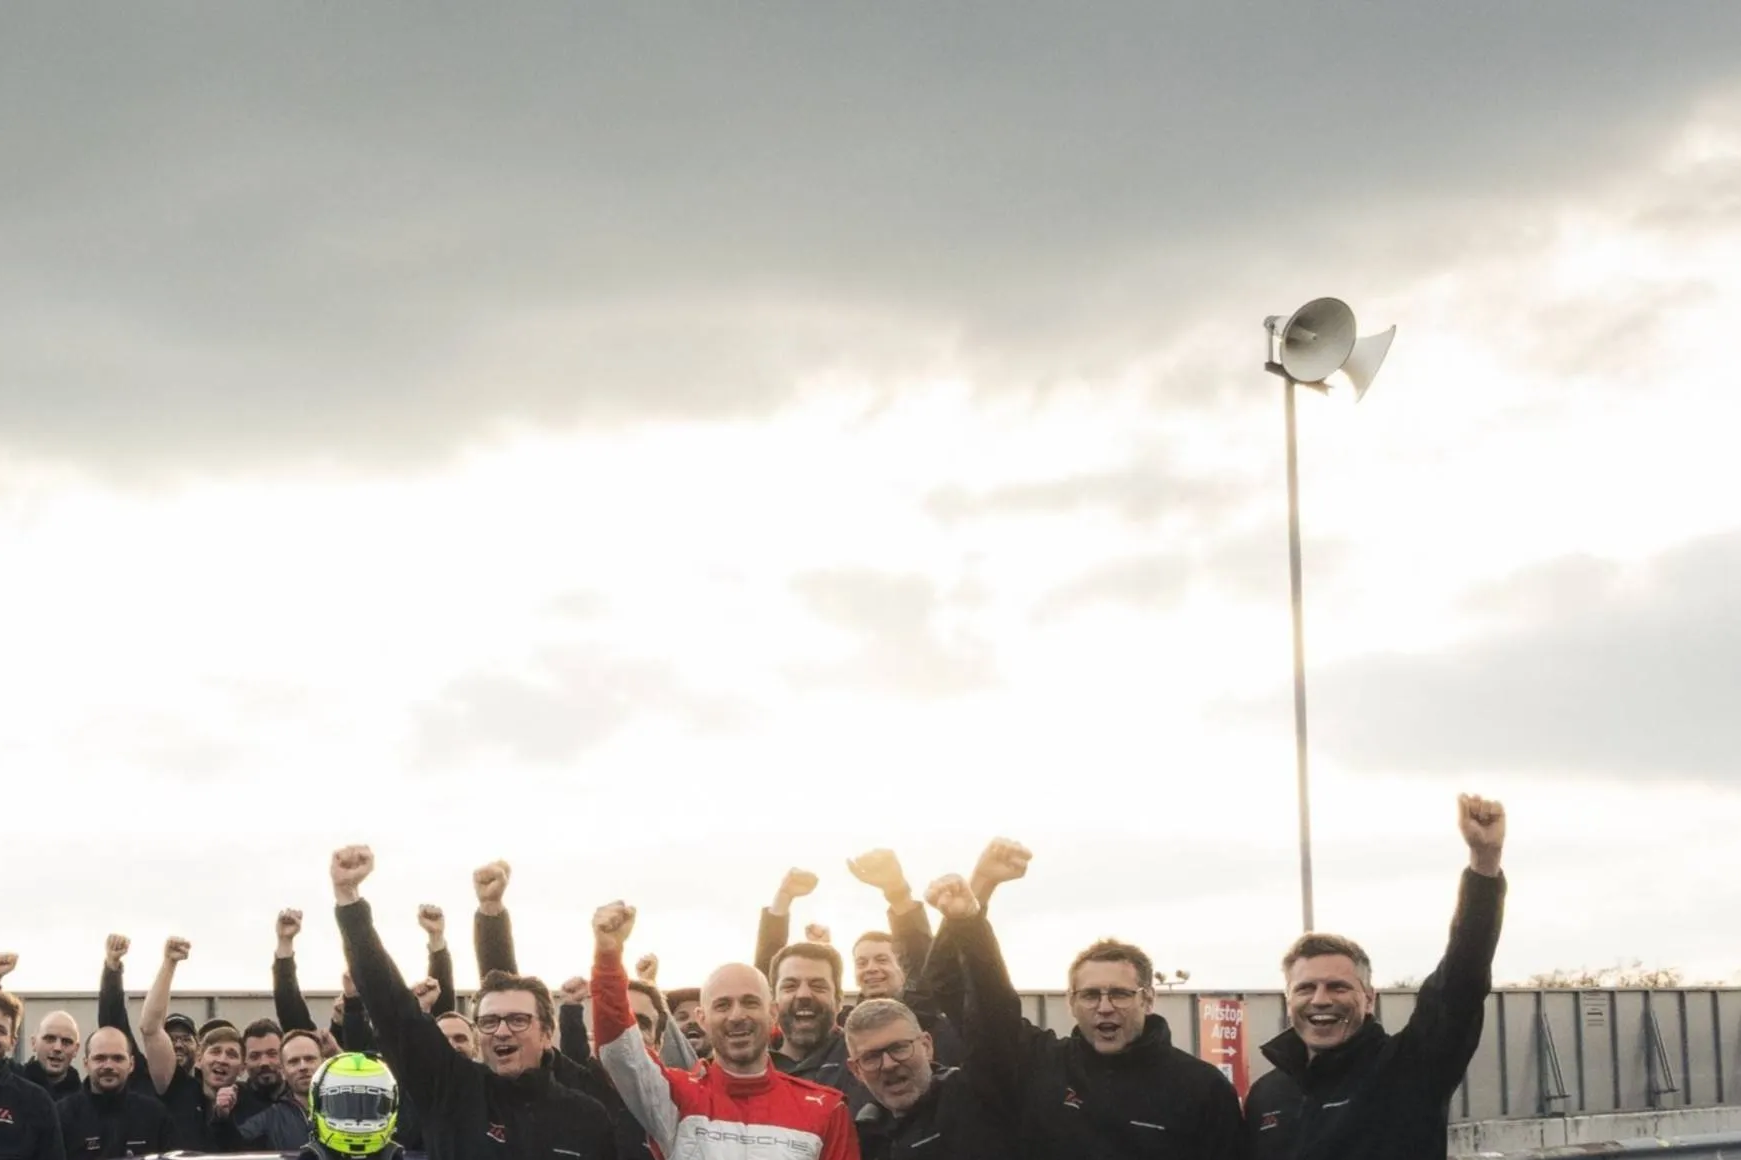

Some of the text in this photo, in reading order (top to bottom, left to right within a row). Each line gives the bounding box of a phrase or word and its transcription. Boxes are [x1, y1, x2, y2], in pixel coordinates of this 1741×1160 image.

[1203, 1003, 1244, 1025] Pitstop
[1210, 1023, 1238, 1040] Area
[695, 1127, 811, 1152] PORSCHE
